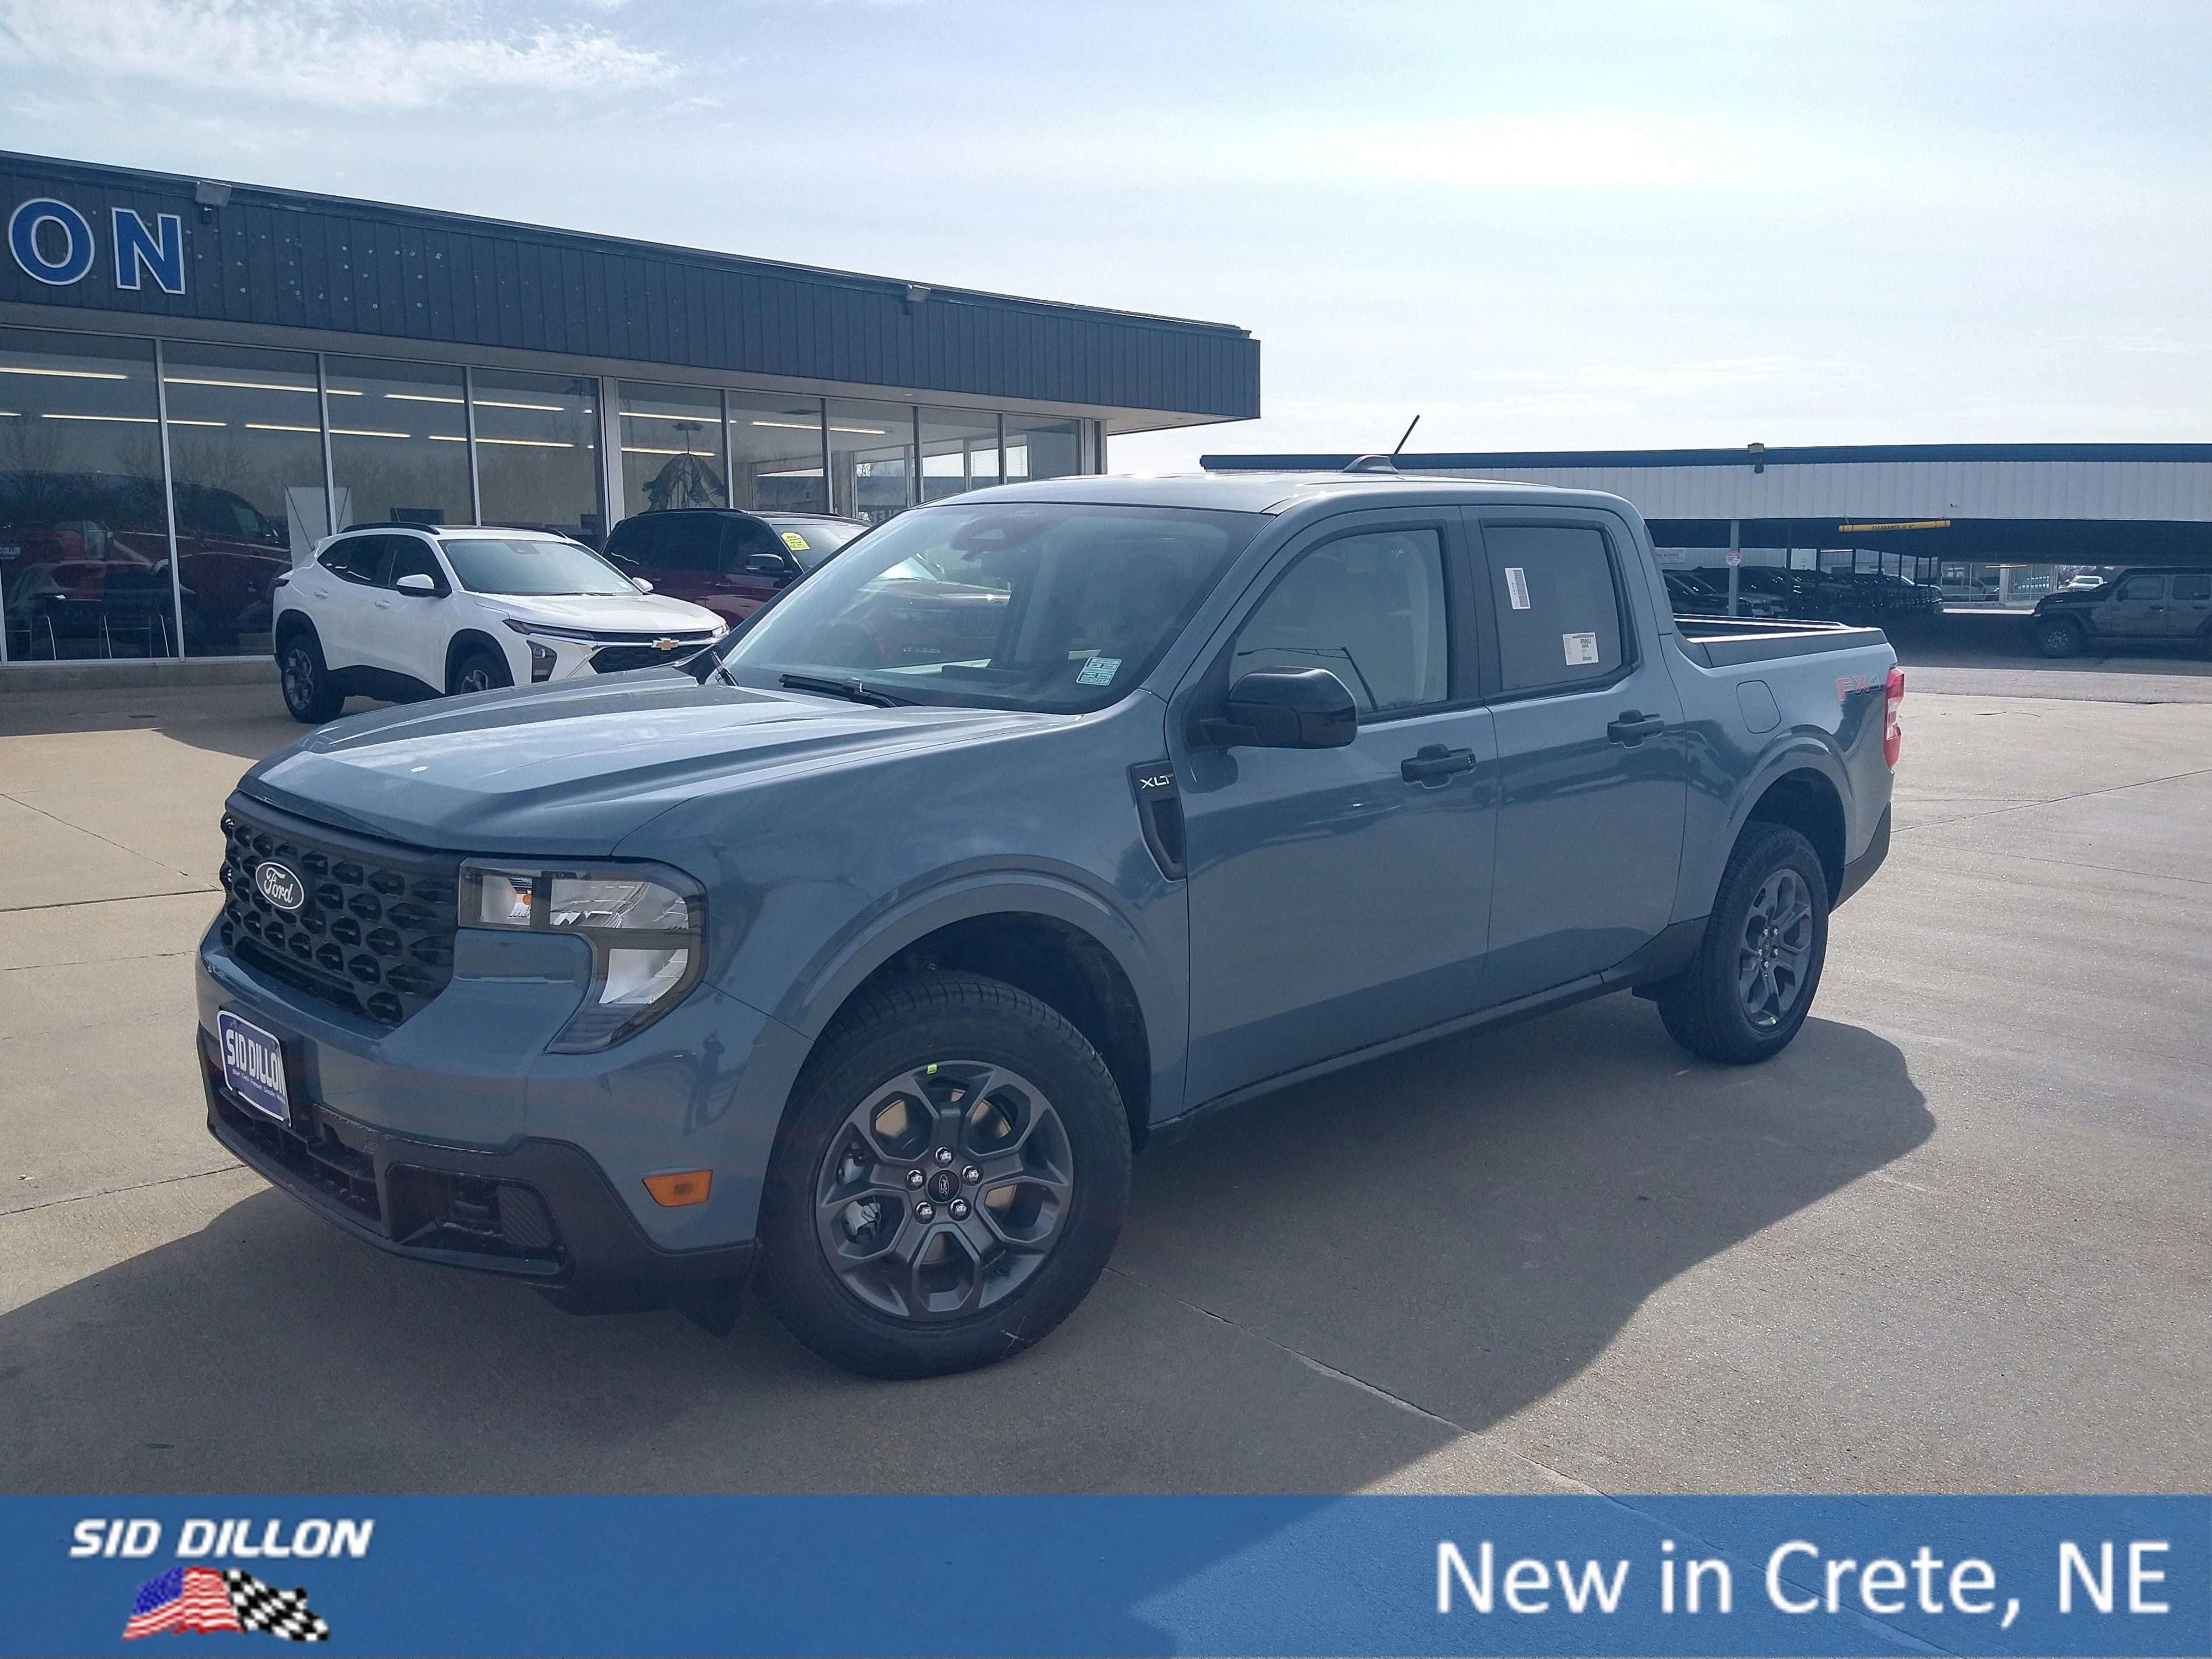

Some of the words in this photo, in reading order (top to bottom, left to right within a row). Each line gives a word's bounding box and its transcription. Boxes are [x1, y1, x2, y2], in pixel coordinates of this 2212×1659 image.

[8, 197, 185, 295] ON
[1837, 672, 1881, 702] FX4
[1140, 774, 1174, 789] XLT
[264, 867, 293, 904] Ford
[226, 1029, 247, 1072] SID
[248, 1039, 286, 1097] DILLON
